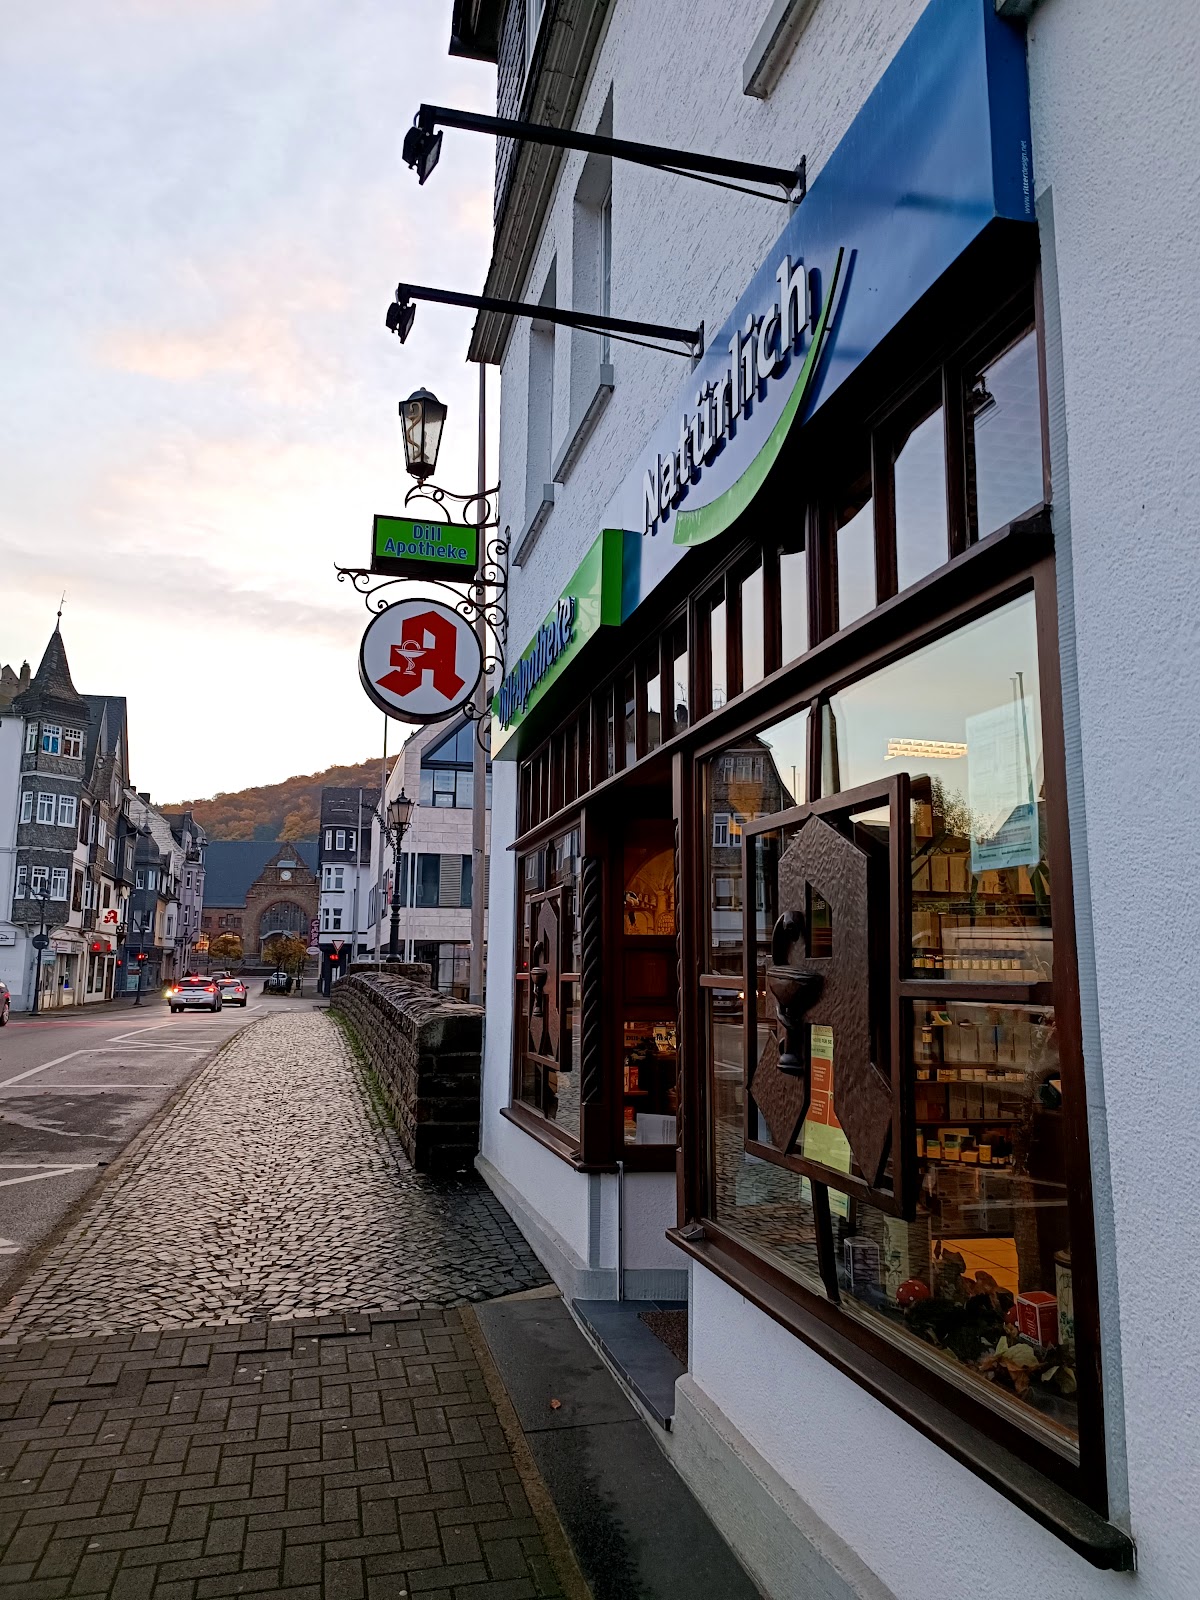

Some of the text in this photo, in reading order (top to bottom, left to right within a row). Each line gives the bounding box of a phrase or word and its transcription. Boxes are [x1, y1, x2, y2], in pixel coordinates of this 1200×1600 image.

[1020, 140, 1031, 214] www.ritterdesign.net
[643, 255, 811, 536] Natürlich
[384, 537, 468, 560] Apotheke
[412, 524, 442, 541] Dill
